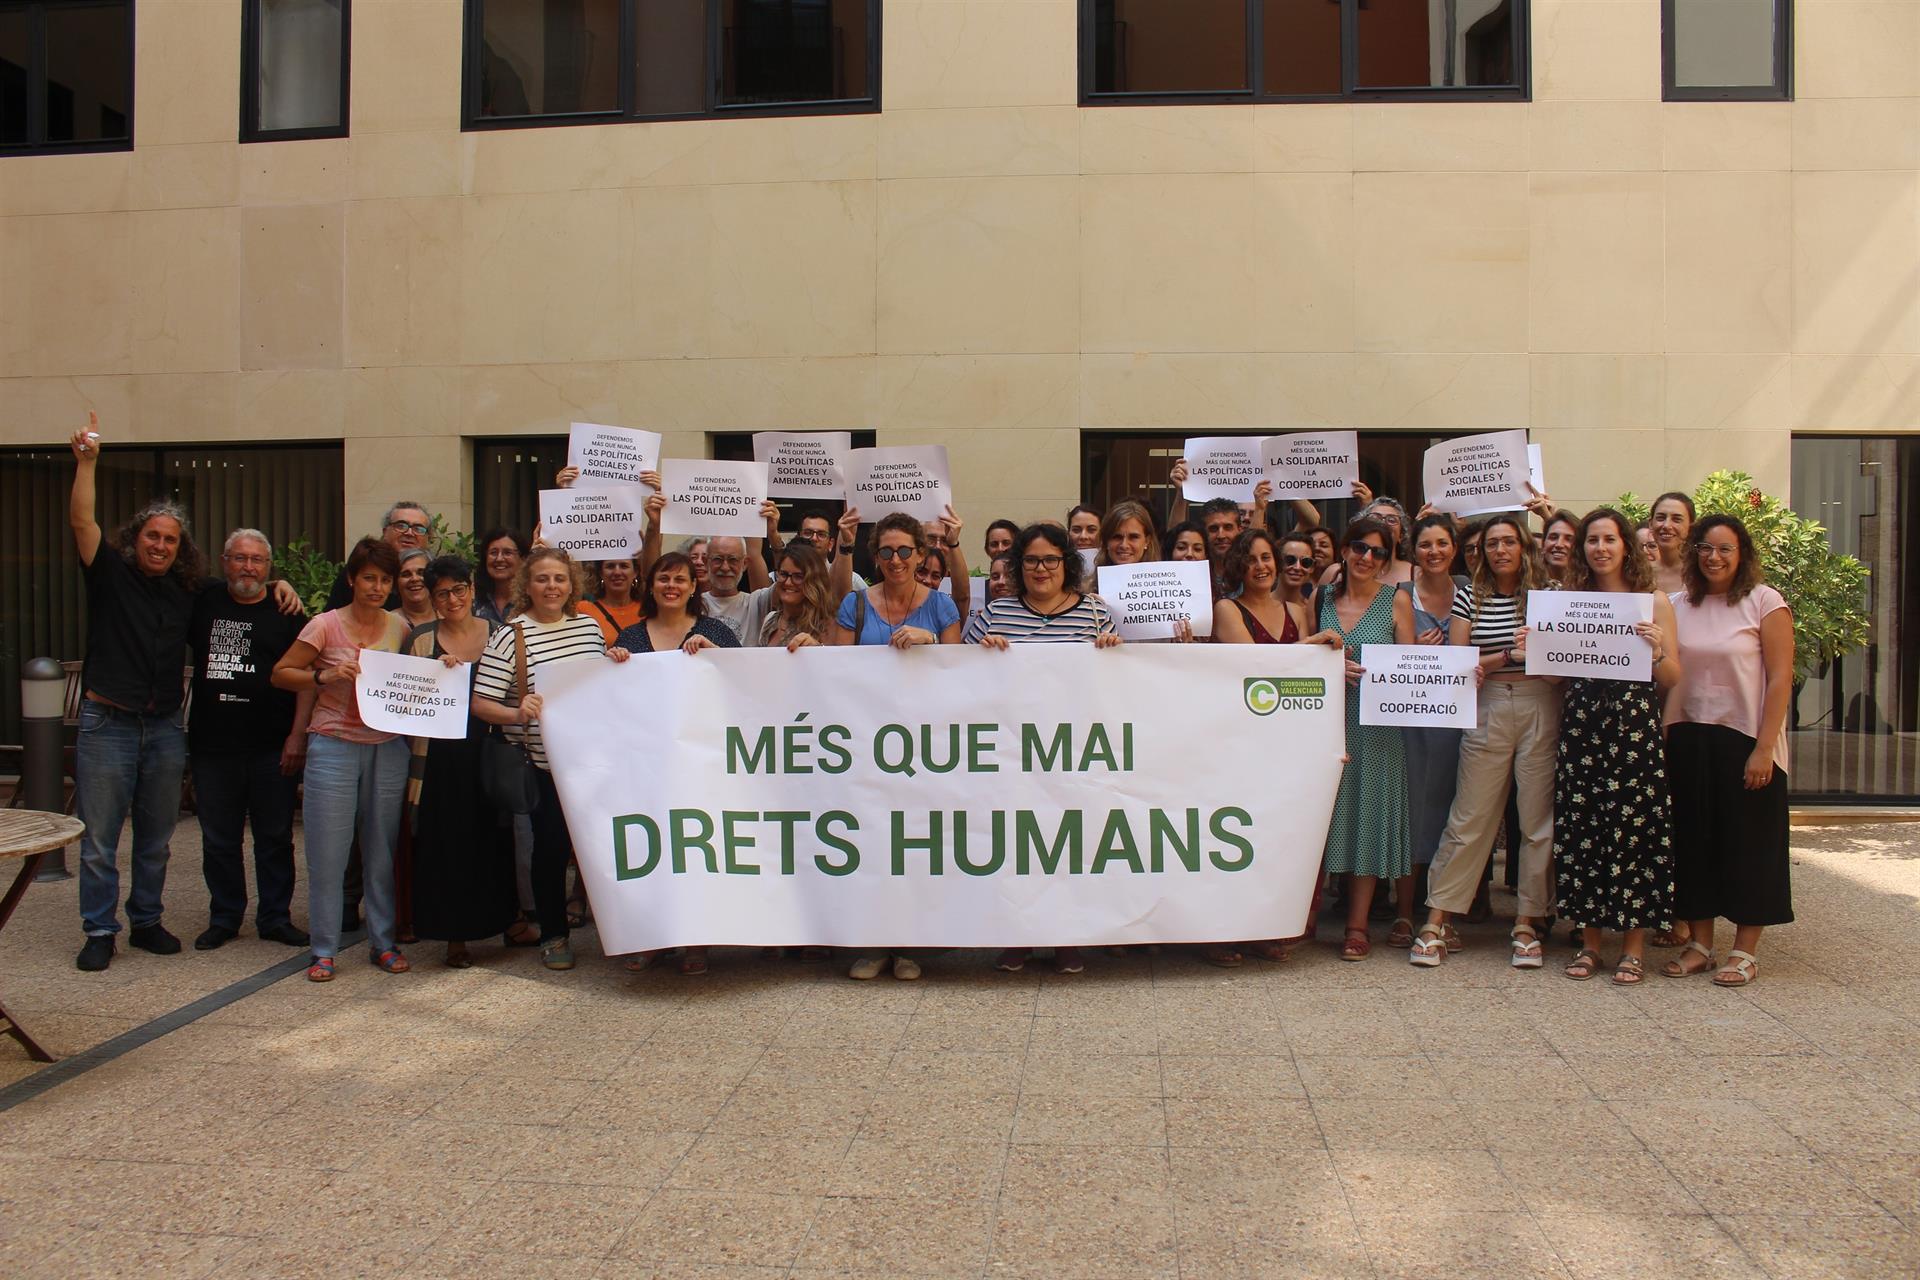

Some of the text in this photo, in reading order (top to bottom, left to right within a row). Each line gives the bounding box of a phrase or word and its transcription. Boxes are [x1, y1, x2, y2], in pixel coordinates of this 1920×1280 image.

[597, 434, 633, 443] DEFENDEMOS
[583, 448, 643, 461] LAS POLÍTICAS
[1452, 444, 1494, 454] DEFENDEMOS
[588, 459, 627, 470] SOCIALES
[789, 457, 834, 465] POLÍTICAS
[1286, 455, 1349, 465] SOLIDARITAT
[874, 463, 917, 471] DEFENDEMOS
[1210, 467, 1252, 475] POLÍTICAS
[1440, 460, 1510, 476] LAS POLÍTICAS
[582, 469, 638, 481] AMBIENTALES
[1449, 474, 1495, 486] SOCIALES
[773, 477, 832, 485] AMBIENTALES
[856, 480, 939, 491] LAS POLÍTICAS DE
[1279, 477, 1342, 489] COOPERACIÓ
[1445, 484, 1510, 498] AMBIENTALES
[673, 494, 756, 505] LAS POLÍTICAS DE
[874, 493, 921, 503] IGUALDAD
[691, 507, 737, 516] IGUALDAD
[550, 513, 633, 524] LA SOLIDARITAT
[558, 537, 627, 550] COOPERACIÓ
[1119, 588, 1191, 600] LAS POLÍTICAS
[1128, 601, 1175, 611] SOCIALES
[1123, 613, 1191, 624] AMBIENTALES
[213, 619, 252, 630] LOS BANCOS
[1538, 622, 1639, 635] LA SOLIDARITA
[211, 628, 243, 638] INVIERTEN
[210, 636, 251, 647] MILLONES EN
[231, 655, 241, 663] DE
[1547, 653, 1630, 666] COOPERACIÓ
[208, 662, 255, 672] FINANCIAR LA
[207, 671, 234, 679] GUERRA.
[393, 673, 436, 684] DEFENDEMOS
[1372, 674, 1467, 686] LA SOLIDARITAT
[367, 688, 456, 706] LAS POLÍTICAS DE
[1282, 699, 1323, 710] ONGD
[1380, 702, 1457, 715] COOPERACIÓ
[385, 704, 435, 717] IGUALDAD
[725, 712, 1134, 778] MÉS QUE MAI
[612, 806, 1254, 882] DRETS HUMANS
